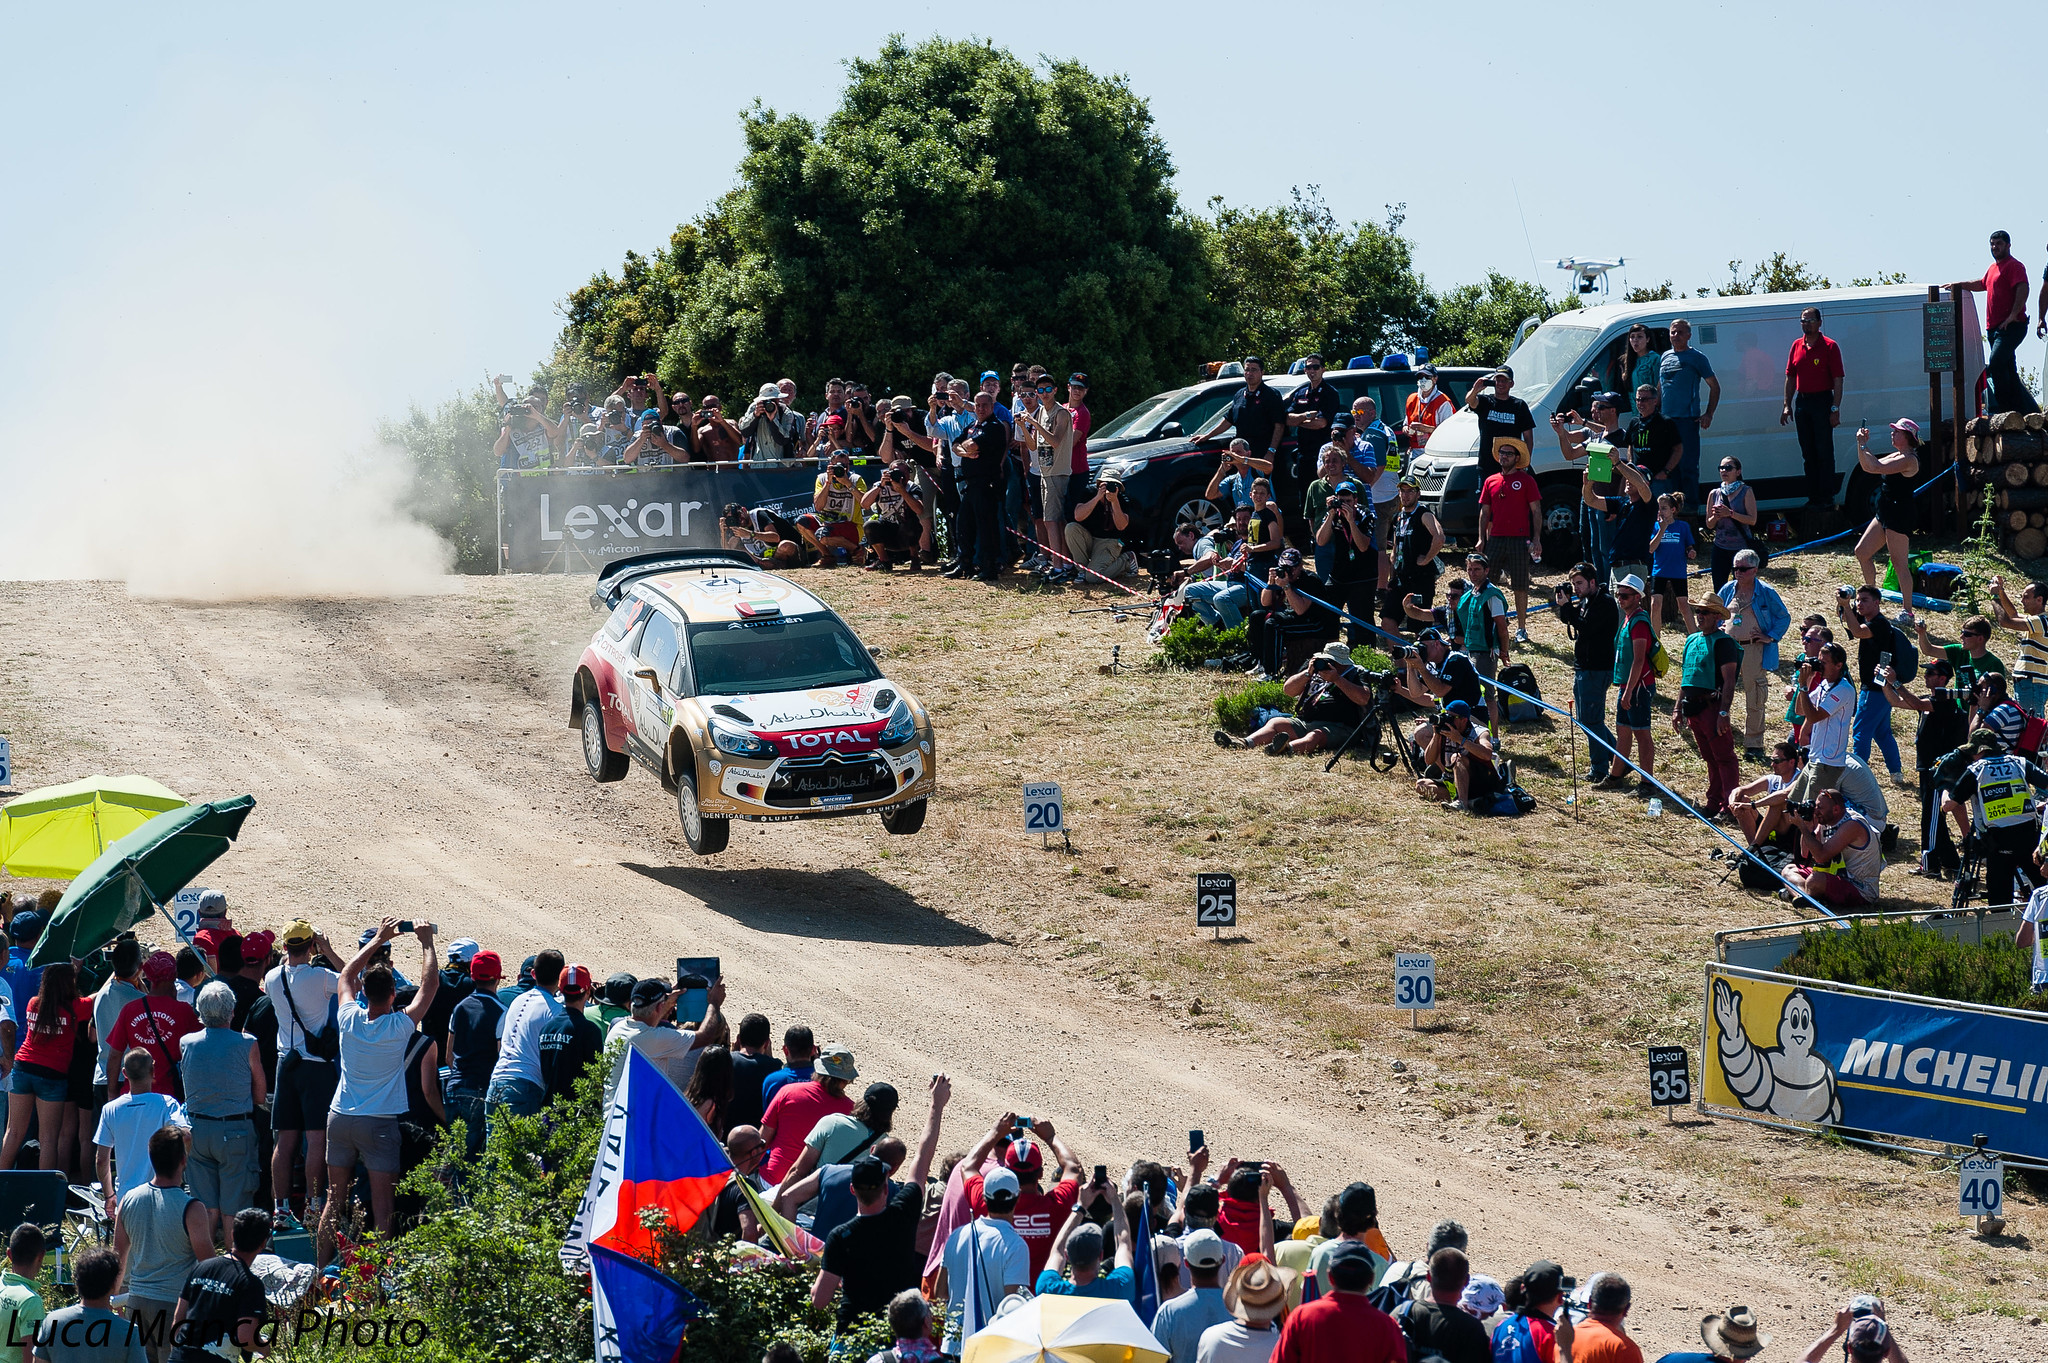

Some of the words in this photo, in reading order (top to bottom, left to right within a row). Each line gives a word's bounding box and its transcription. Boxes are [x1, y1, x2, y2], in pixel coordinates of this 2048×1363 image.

[540, 494, 703, 541] Lexar
[598, 543, 641, 556] Micron
[782, 729, 871, 750] TOTAL
[1988, 764, 2013, 777] 212
[1025, 786, 1058, 797] Lexar
[1983, 786, 2008, 797] Lexar
[873, 804, 901, 813] LUHTA
[1988, 808, 2007, 818] 2014
[1027, 802, 1061, 829] 20
[1200, 877, 1232, 888] Lexar
[1200, 894, 1234, 922] 25
[1398, 956, 1431, 968] Lexar
[1398, 975, 1433, 1004] 30
[1650, 1051, 1684, 1063] Lexar
[1652, 1069, 1688, 1101] 35
[1962, 1158, 1999, 1170] Lexar
[1961, 1178, 2000, 1210] 40
